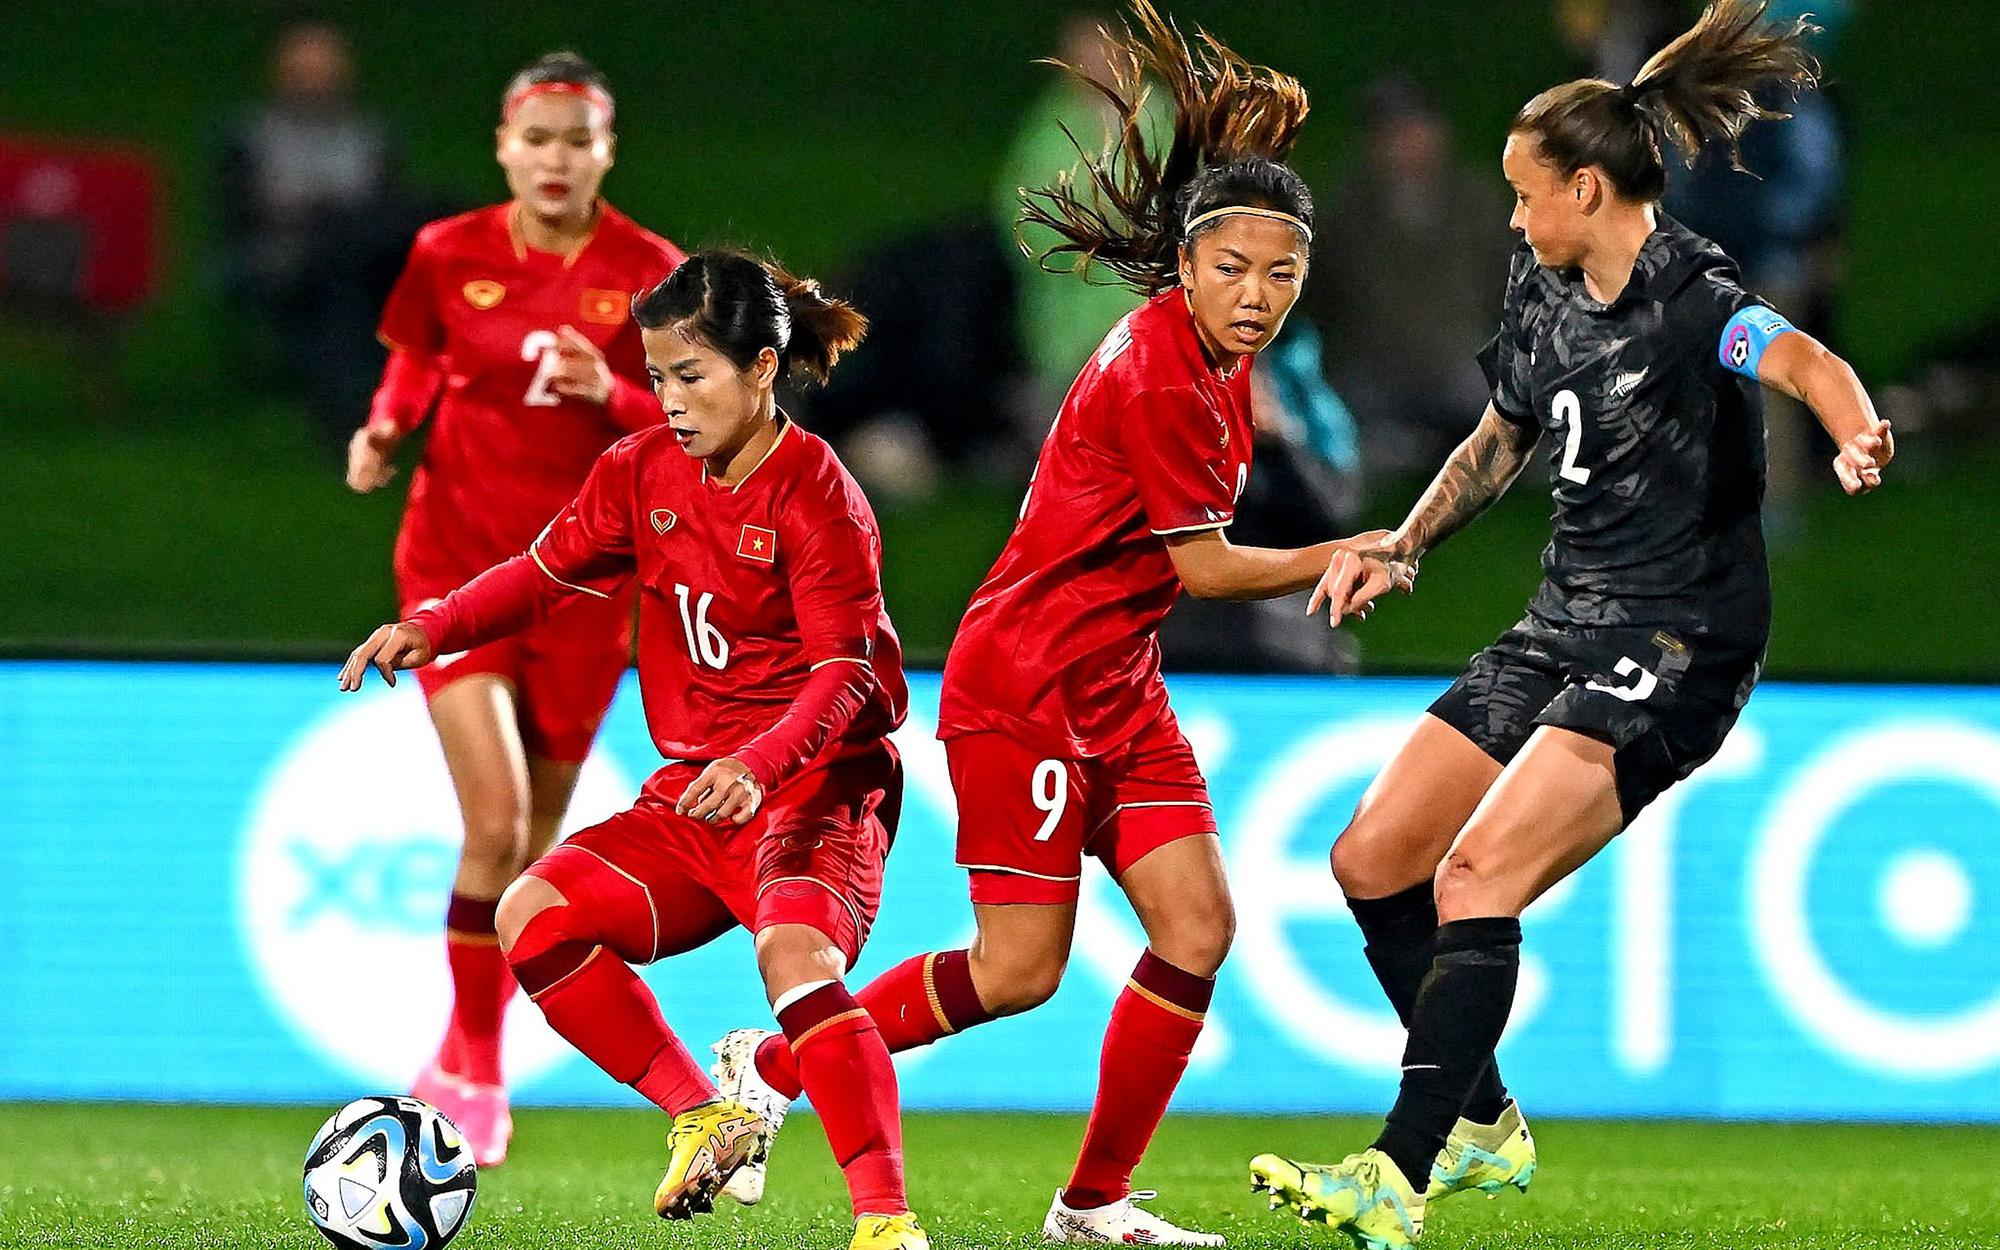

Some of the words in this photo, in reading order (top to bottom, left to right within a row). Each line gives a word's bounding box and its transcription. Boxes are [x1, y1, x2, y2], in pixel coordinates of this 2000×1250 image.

[1552, 389, 1591, 486] 2
[674, 582, 729, 670] 16
[1031, 759, 1068, 842] 9
[286, 837, 468, 935] xe
